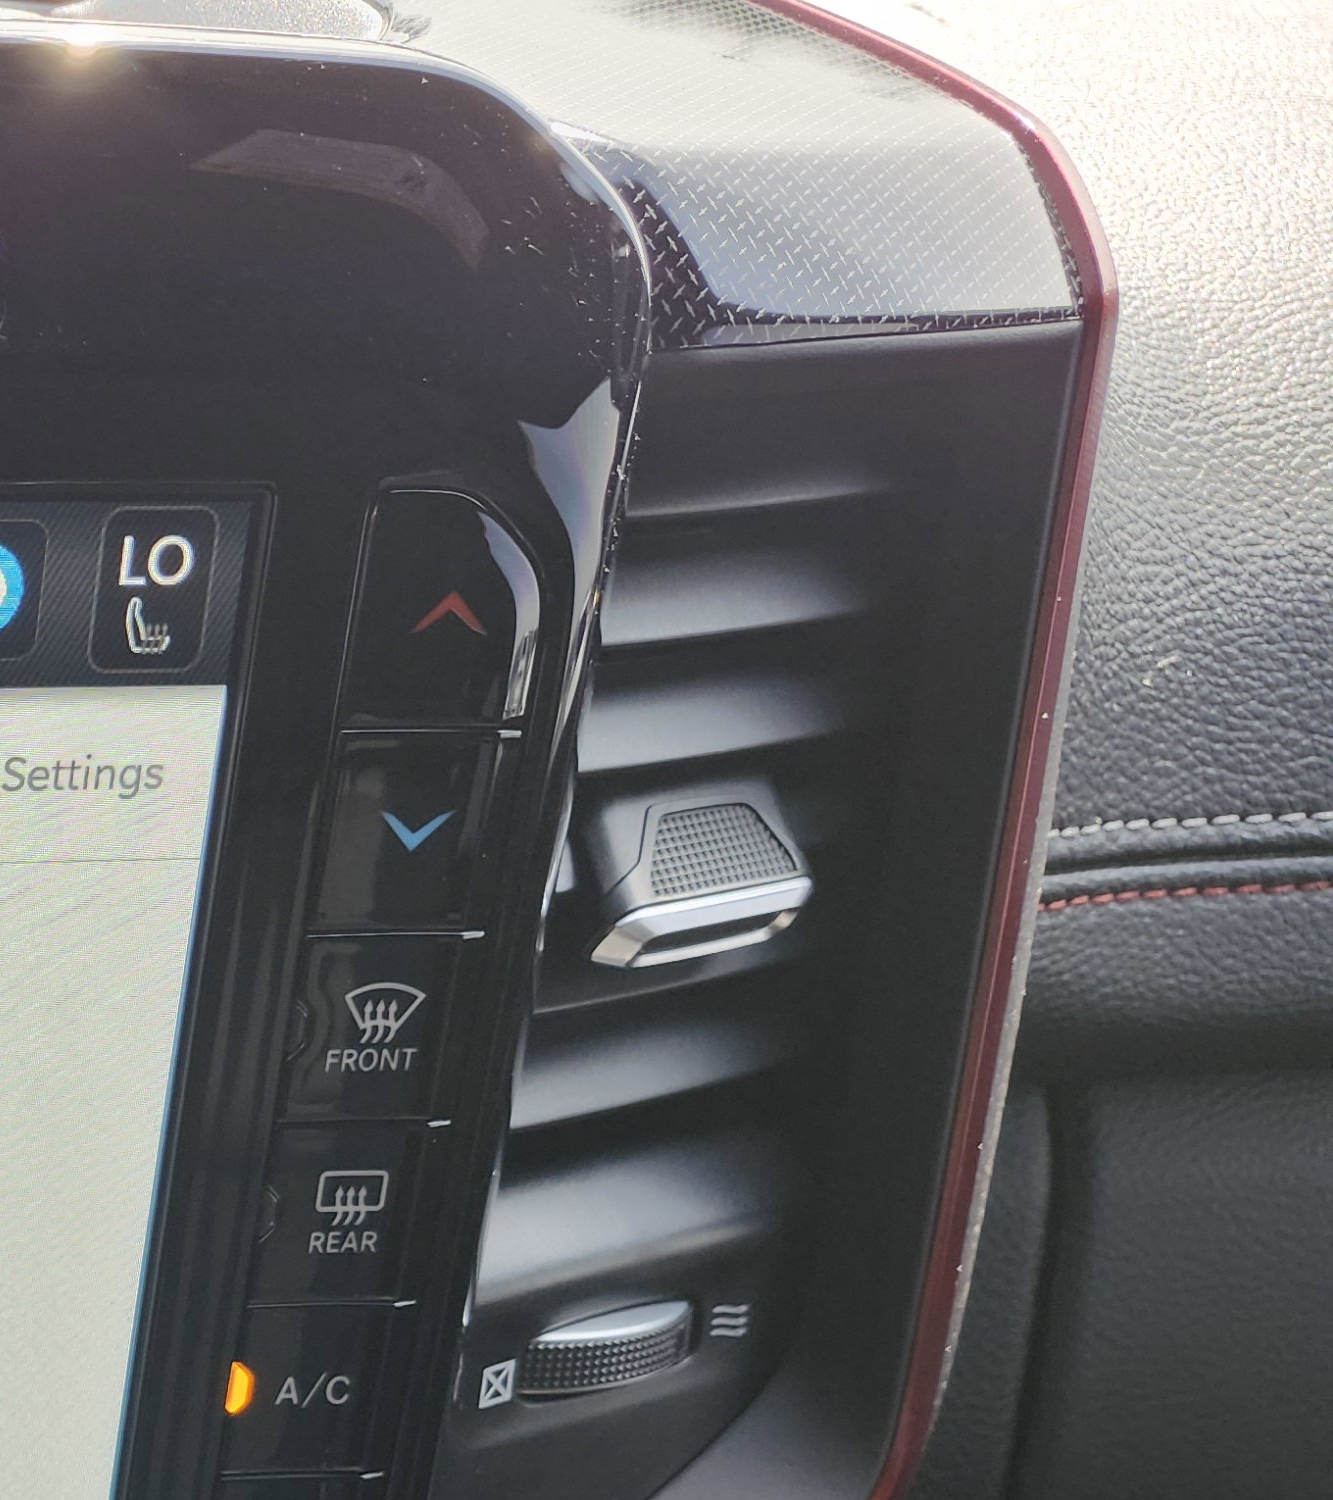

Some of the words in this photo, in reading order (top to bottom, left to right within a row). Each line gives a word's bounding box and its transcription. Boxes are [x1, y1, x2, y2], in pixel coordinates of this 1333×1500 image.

[118, 534, 194, 586] LO
[2, 755, 165, 801] Settings
[324, 1047, 416, 1072] FRONT
[308, 1232, 377, 1254] REAR
[275, 1374, 351, 1407] A/C
